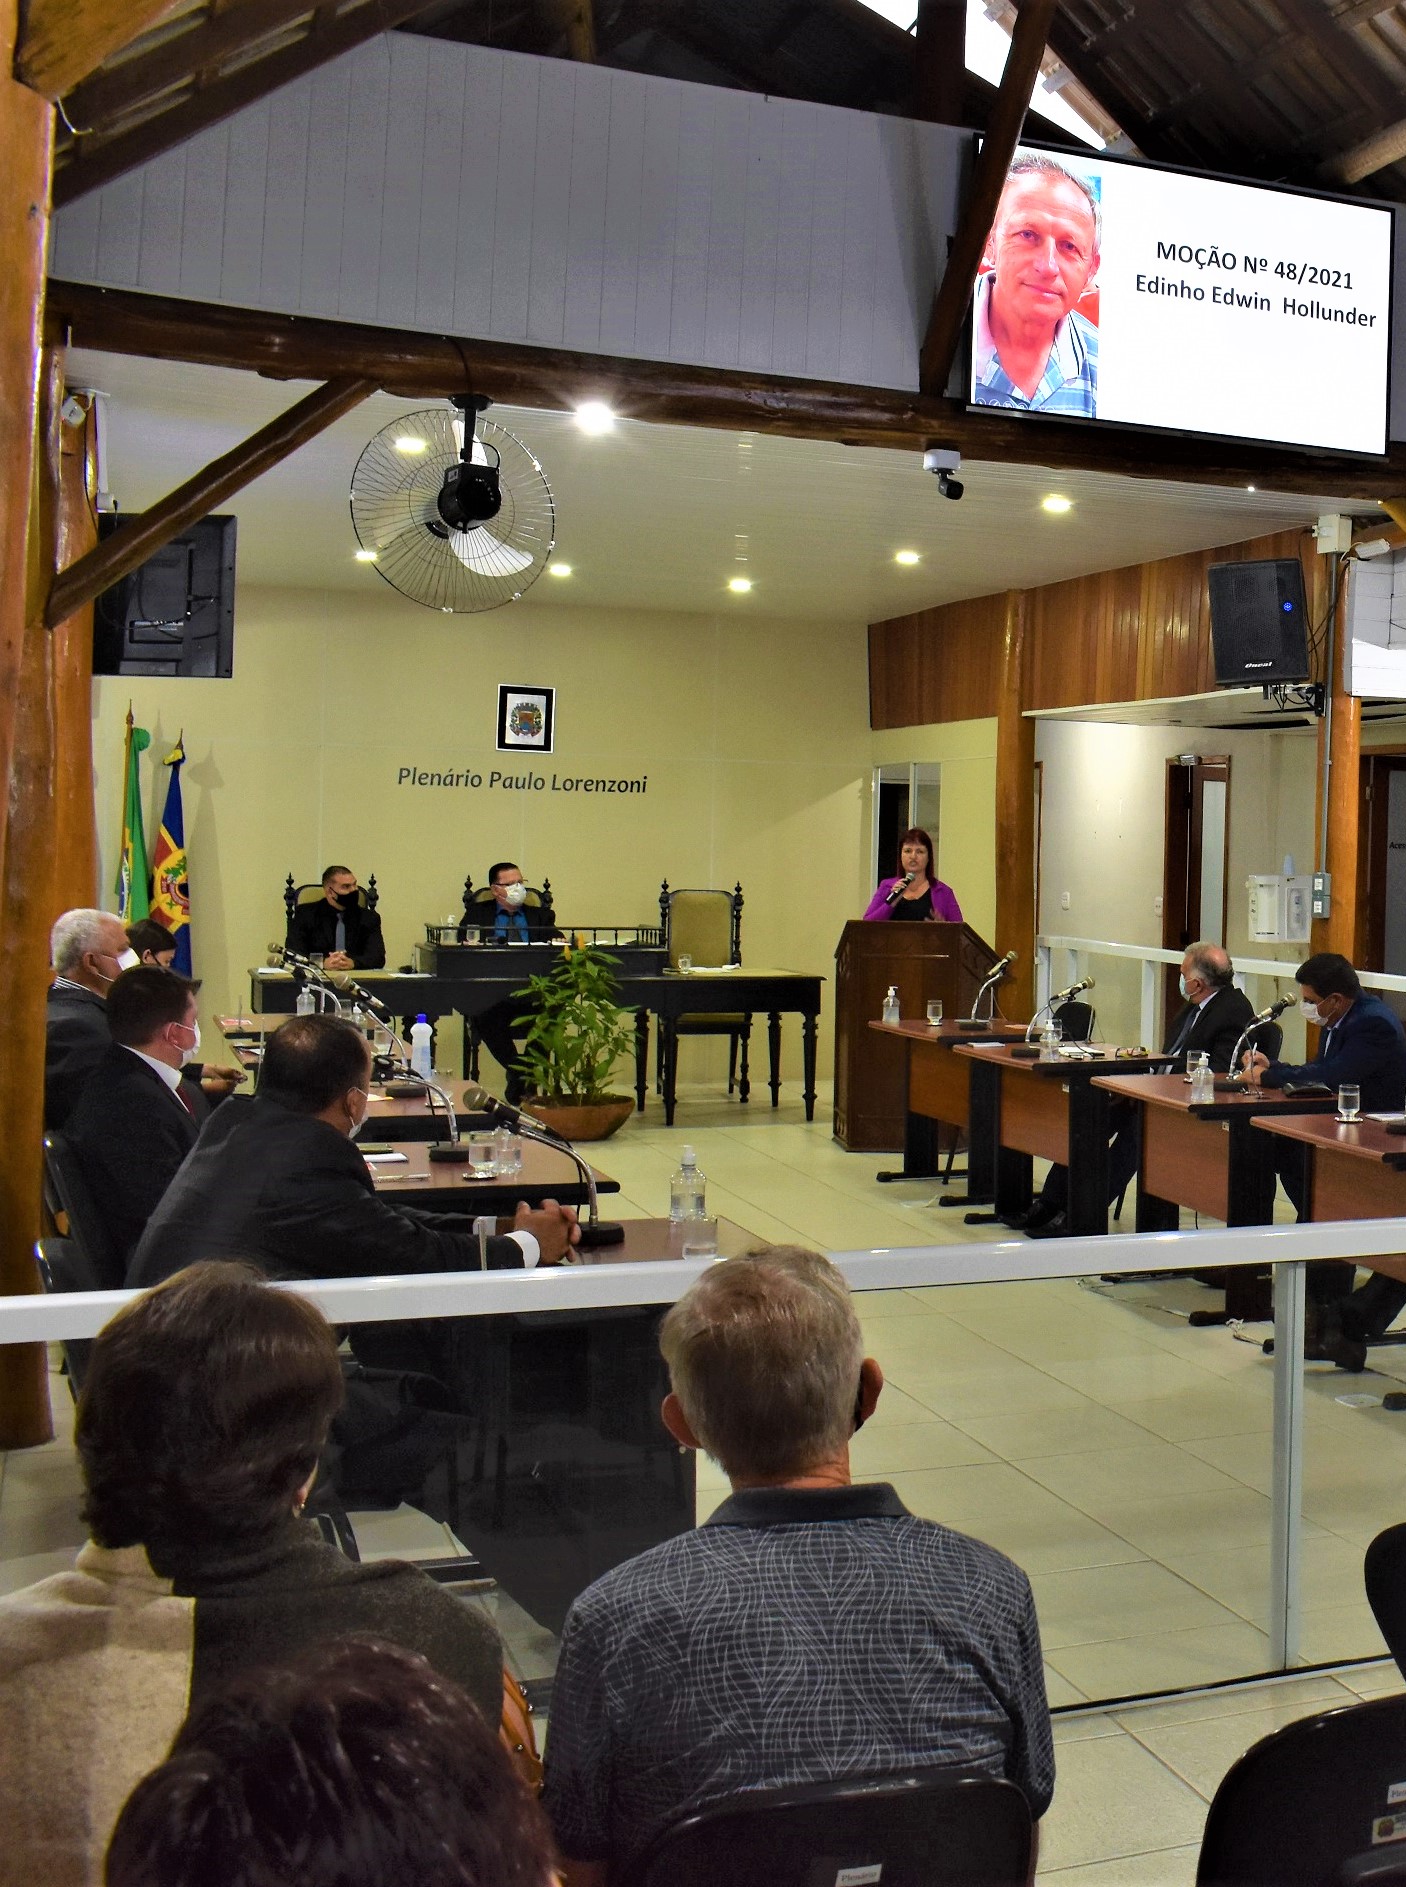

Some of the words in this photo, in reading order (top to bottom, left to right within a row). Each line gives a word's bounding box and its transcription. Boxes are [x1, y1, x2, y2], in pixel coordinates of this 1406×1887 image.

[1157, 241, 1237, 270] MOÇÃO
[1244, 255, 1268, 274] Nº
[1274, 261, 1353, 289] 48/2021
[1136, 274, 1205, 301] Edinho
[1212, 285, 1271, 312] Edwin
[1283, 297, 1376, 328] Hollunder
[398, 767, 483, 788] Plenário
[489, 771, 546, 791] Paulo
[551, 774, 648, 793] Lorenzoni
